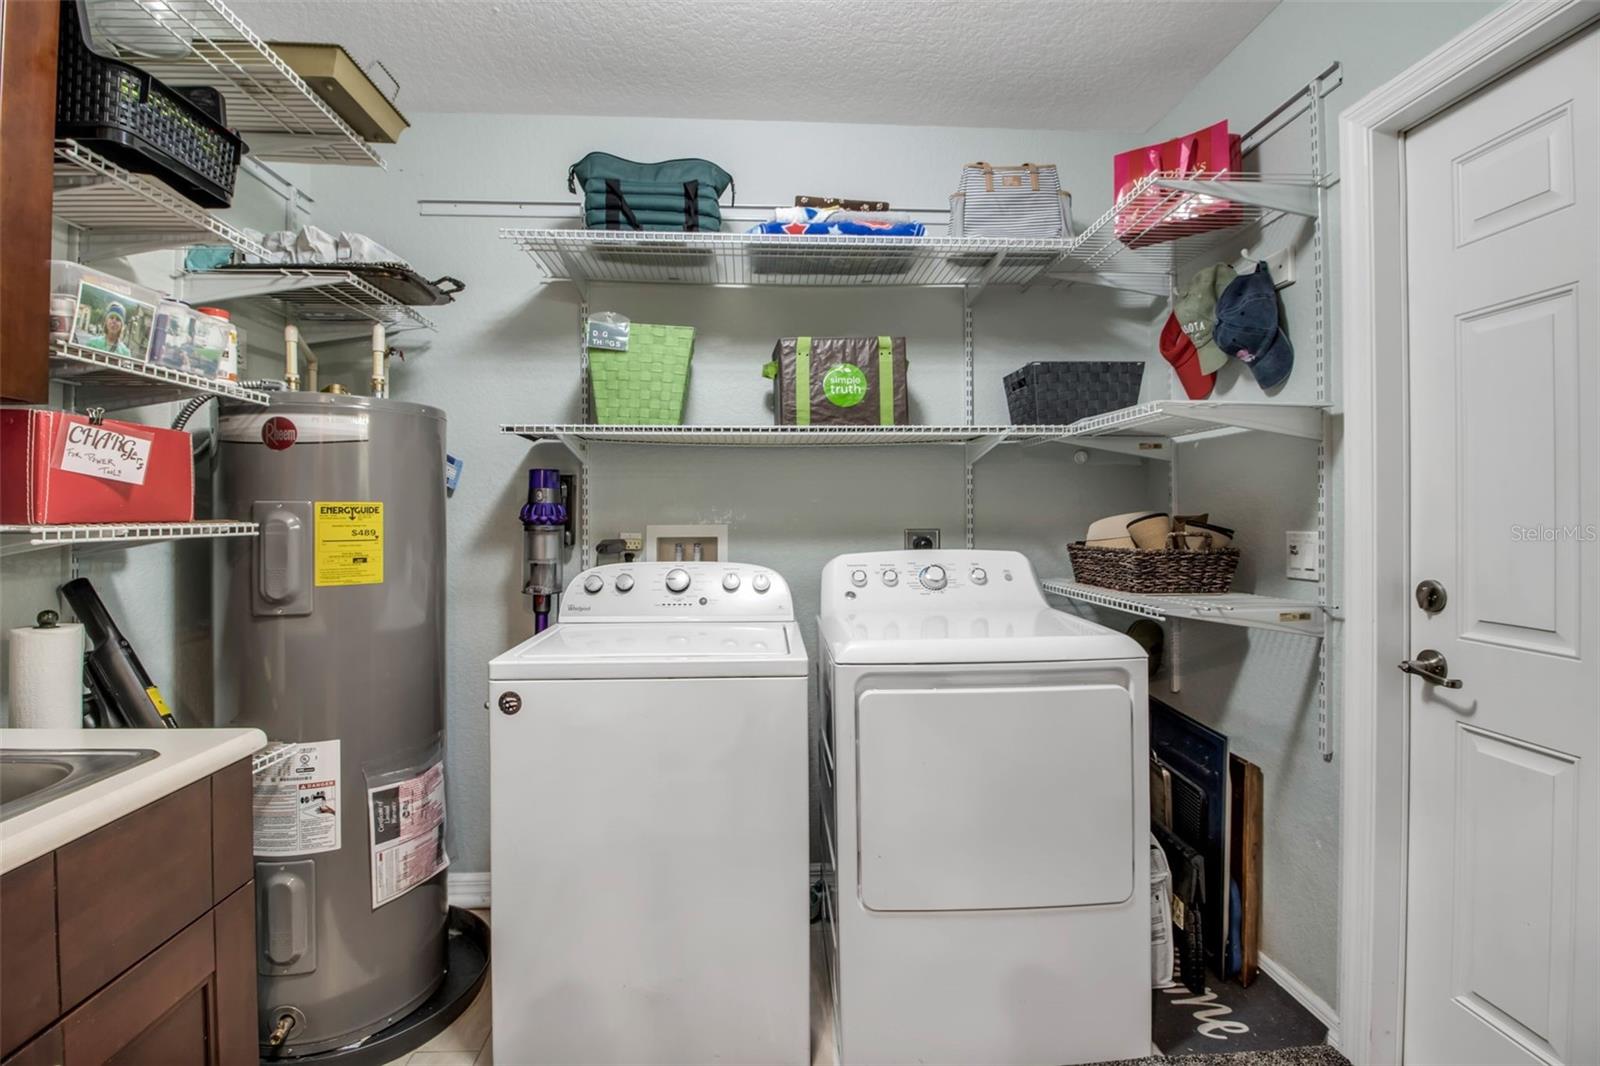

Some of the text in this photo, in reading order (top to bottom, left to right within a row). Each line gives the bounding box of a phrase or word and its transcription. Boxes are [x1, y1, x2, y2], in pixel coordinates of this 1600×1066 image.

[592, 329, 609, 338] DG
[831, 375, 861, 385] simple
[831, 384, 861, 395] truth
[265, 417, 296, 446] Rheem
